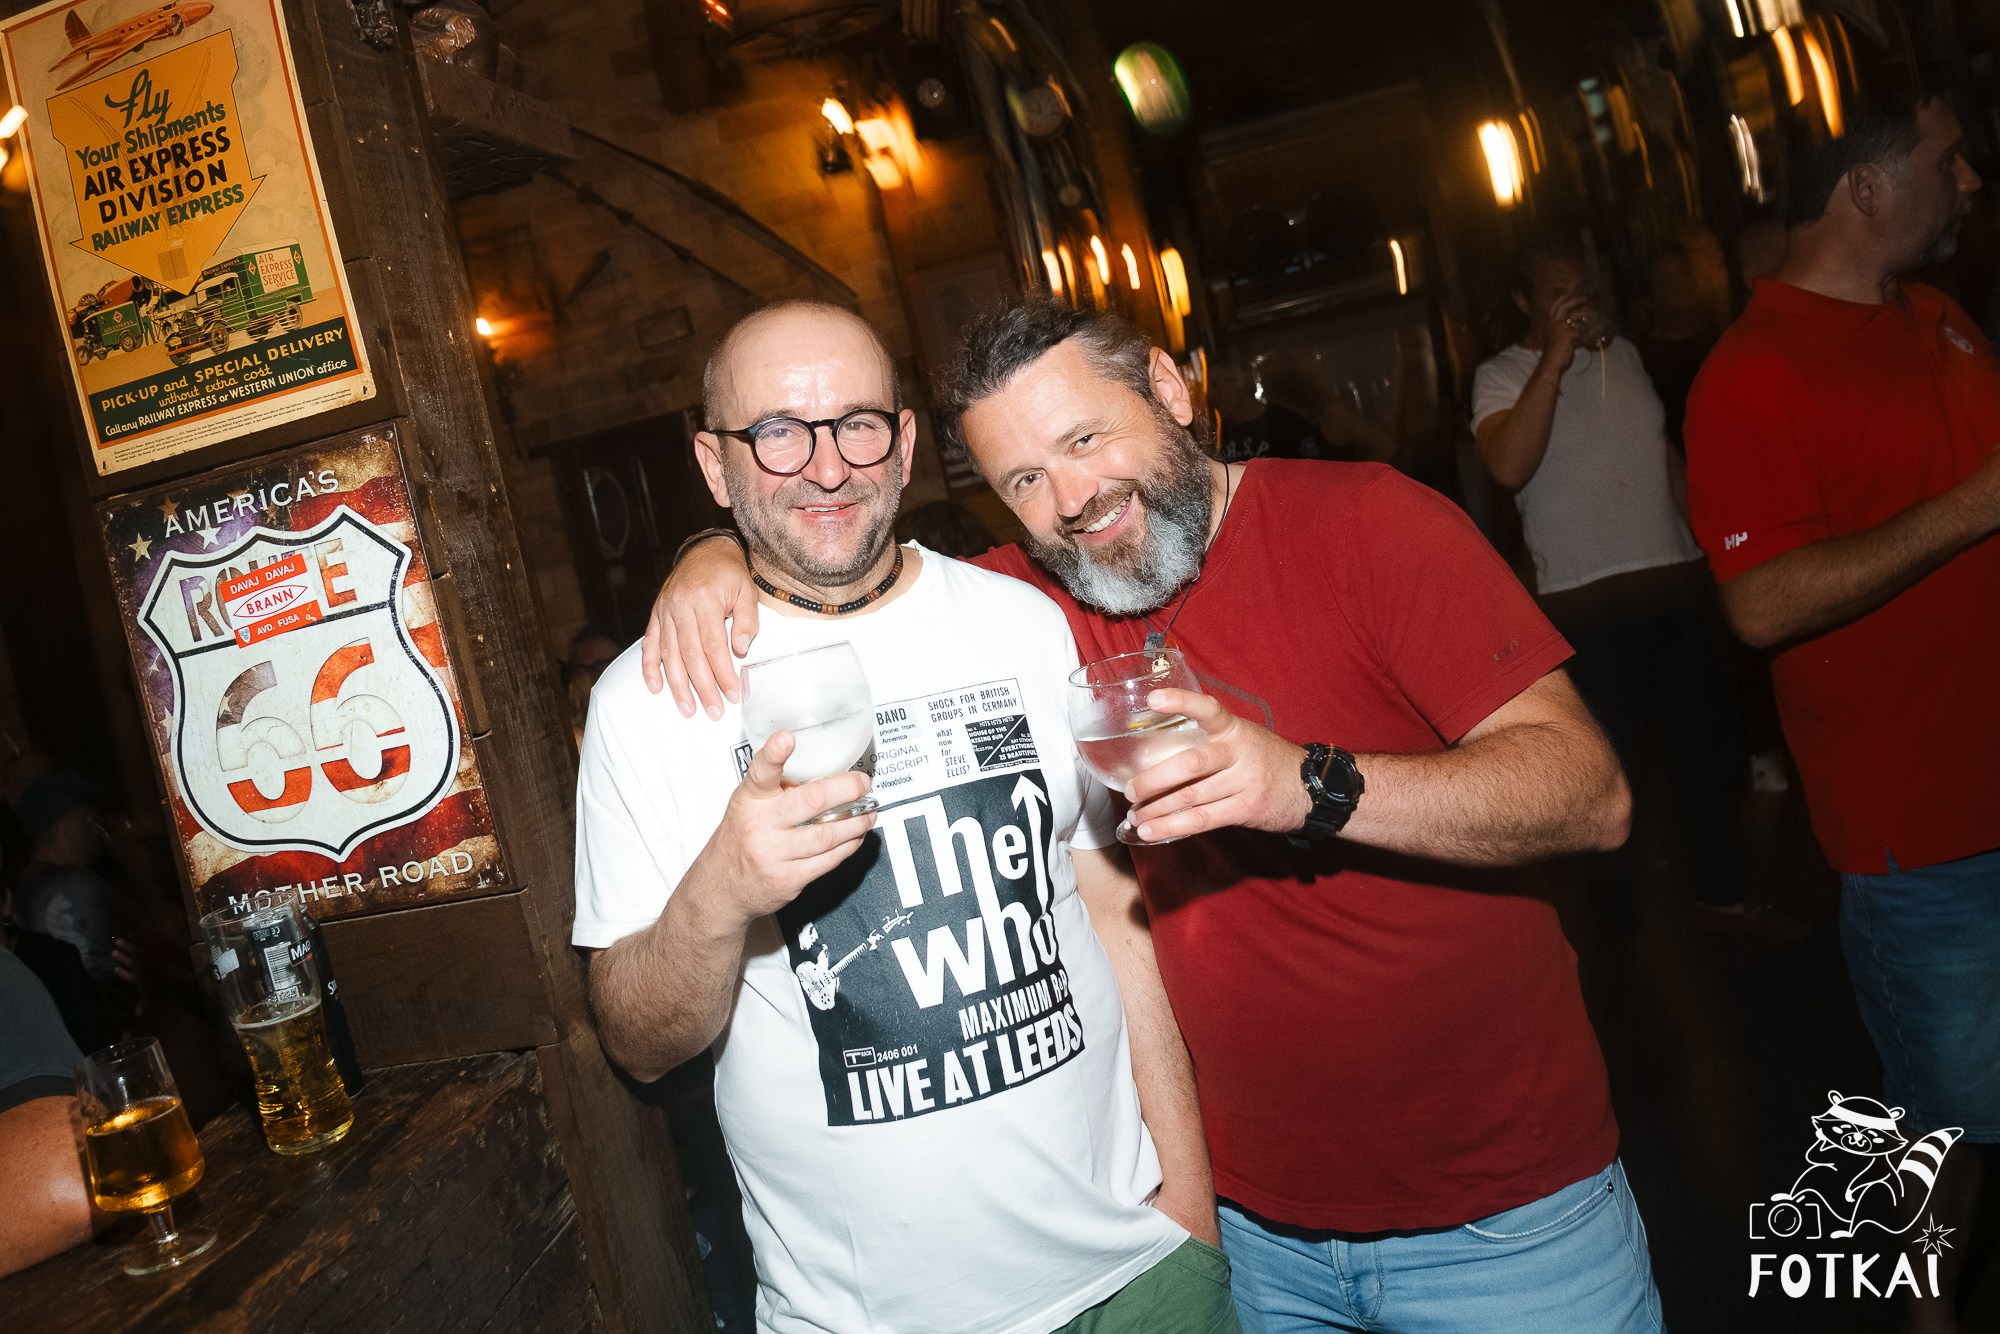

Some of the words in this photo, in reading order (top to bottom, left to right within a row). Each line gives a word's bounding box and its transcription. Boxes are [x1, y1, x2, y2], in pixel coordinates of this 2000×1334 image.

[104, 68, 173, 129] Fly
[75, 141, 121, 170] Your
[124, 100, 226, 153] Shipments
[84, 167, 123, 201] AIR
[129, 126, 231, 184] EXPRESS
[99, 159, 228, 224] DIVISION
[92, 212, 161, 251] RAILWAY
[168, 184, 245, 226] EXPRESS
[259, 253, 274, 264] AIR
[260, 259, 293, 274] EXPRESS
[263, 270, 295, 285] SERVICE
[101, 385, 158, 411] PICK-UP
[164, 376, 188, 392] and
[195, 353, 263, 383] SPECIAL
[267, 328, 344, 361] DELIVERY
[159, 390, 200, 407] without
[205, 377, 238, 393] extra
[243, 363, 273, 381] cost
[105, 424, 122, 436] Call
[121, 420, 138, 432] any
[138, 406, 176, 427] RAILWAY
[178, 394, 217, 415] EXPRESS
[219, 392, 229, 403] or
[229, 377, 276, 399] WESTERN
[278, 365, 315, 385] UNION
[317, 359, 348, 375] office
[164, 468, 340, 539] AMERICA'S
[230, 576, 259, 594] DAVAJ
[265, 563, 295, 581] DAVAJ
[247, 588, 294, 615] BRANN
[257, 623, 275, 635] AVD.
[278, 614, 300, 627] FUSA
[927, 698, 955, 711] SHOCK
[960, 693, 976, 704] FOR
[980, 686, 1010, 700] BRITISH
[931, 708, 964, 722] GROUPS
[968, 706, 978, 715] IN
[982, 698, 1018, 712] GERMANY
[876, 708, 907, 725] BAND
[216, 637, 411, 824] 66
[880, 728, 899, 736] phone
[902, 723, 917, 731] from
[882, 734, 908, 744] America
[936, 728, 953, 738] what
[968, 729, 988, 738] HOUSE
[992, 733, 1004, 741] SUN
[870, 744, 921, 763] ORIGINAL
[941, 749, 951, 757] for
[945, 755, 967, 767] STEVE
[867, 755, 929, 778] ANUSCRIPT
[947, 765, 971, 778] ELLIS?
[881, 775, 912, 788] Woodstock
[876, 794, 1029, 909] The
[228, 872, 366, 915] MOTHER
[381, 851, 475, 889] ROAD
[891, 900, 1057, 1009] who
[958, 978, 1052, 1042] MAXIMUM
[847, 1058, 935, 1121] LIVE
[944, 1040, 991, 1104] AT
[996, 1003, 1081, 1086] LEEDS
[877, 1049, 899, 1063] 2406
[901, 1044, 918, 1057] 001
